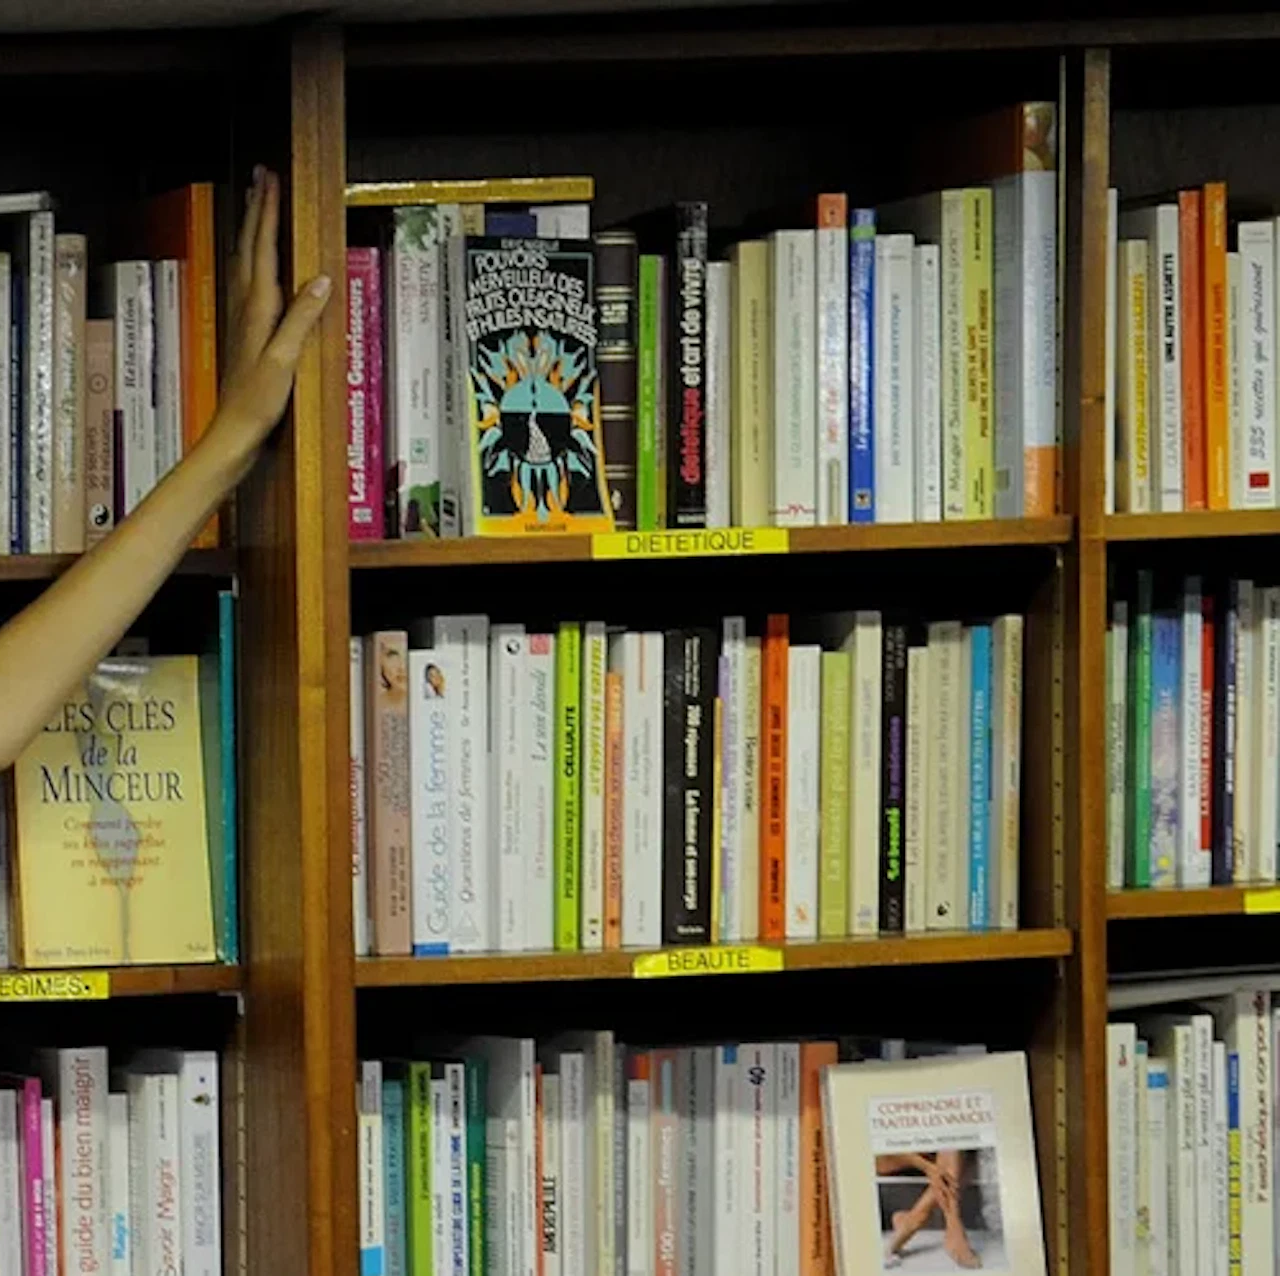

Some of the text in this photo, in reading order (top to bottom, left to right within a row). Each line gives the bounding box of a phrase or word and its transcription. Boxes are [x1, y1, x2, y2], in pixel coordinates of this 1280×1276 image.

[474, 253, 548, 276] POUVOIRS
[679, 258, 703, 307] vivre
[467, 272, 585, 299] MERVEILLEUX DES
[464, 293, 507, 320] FRUITS
[679, 310, 703, 333] de
[1162, 253, 1176, 363] UNE AUTRE ASSIETTE
[123, 297, 137, 388] Relaxation
[679, 335, 703, 363] art
[347, 278, 365, 502] Les Aliments Guérisseurs
[679, 365, 703, 386] et
[626, 531, 754, 553] DIETETIQUE
[41, 699, 177, 733] LES CLÉS
[80, 732, 139, 768] de la
[41, 766, 184, 804] MINCEUR
[425, 711, 449, 934] Guide de la femme
[457, 738, 475, 904] Questions de femmes
[667, 949, 750, 971] BEAUTE
[72, 1056, 98, 1127] maigrir
[878, 1096, 981, 1114] COMPRENDRE ET
[72, 1132, 98, 1177] bien
[658, 1126, 673, 1187] femmes
[72, 1183, 98, 1210] du
[154, 1158, 178, 1221] Maigrir
[72, 1216, 98, 1273] guide
[113, 1213, 128, 1259] Maigrir
